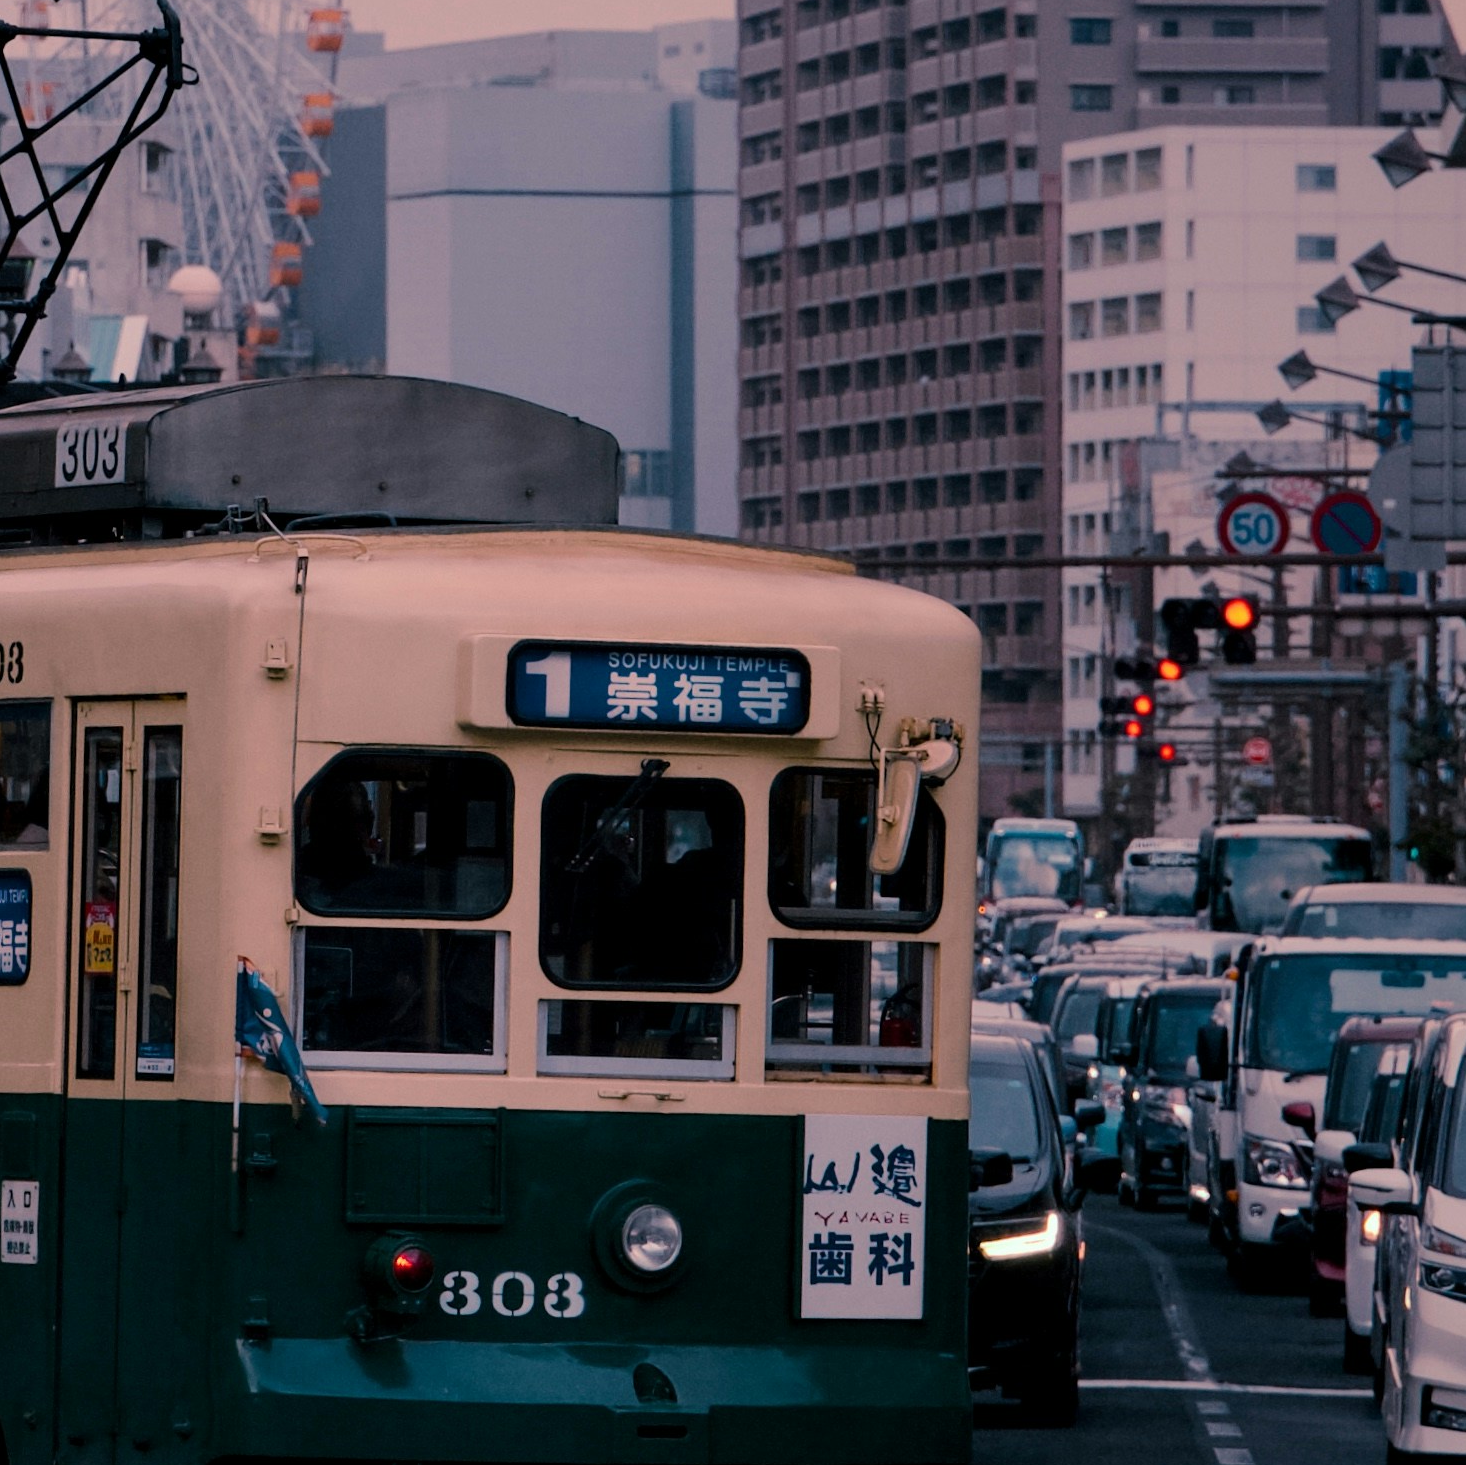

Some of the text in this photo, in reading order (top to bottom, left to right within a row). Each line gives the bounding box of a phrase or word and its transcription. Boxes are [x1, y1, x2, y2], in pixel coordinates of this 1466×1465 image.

[62, 426, 119, 482] 303
[1234, 512, 1274, 544] 50
[525, 651, 571, 718] 1
[608, 652, 789, 673] SOFUKUJI TEMPLE
[607, 672, 789, 725] 崇福寺
[809, 1232, 915, 1286] 歯科
[439, 1270, 586, 1319] 303
